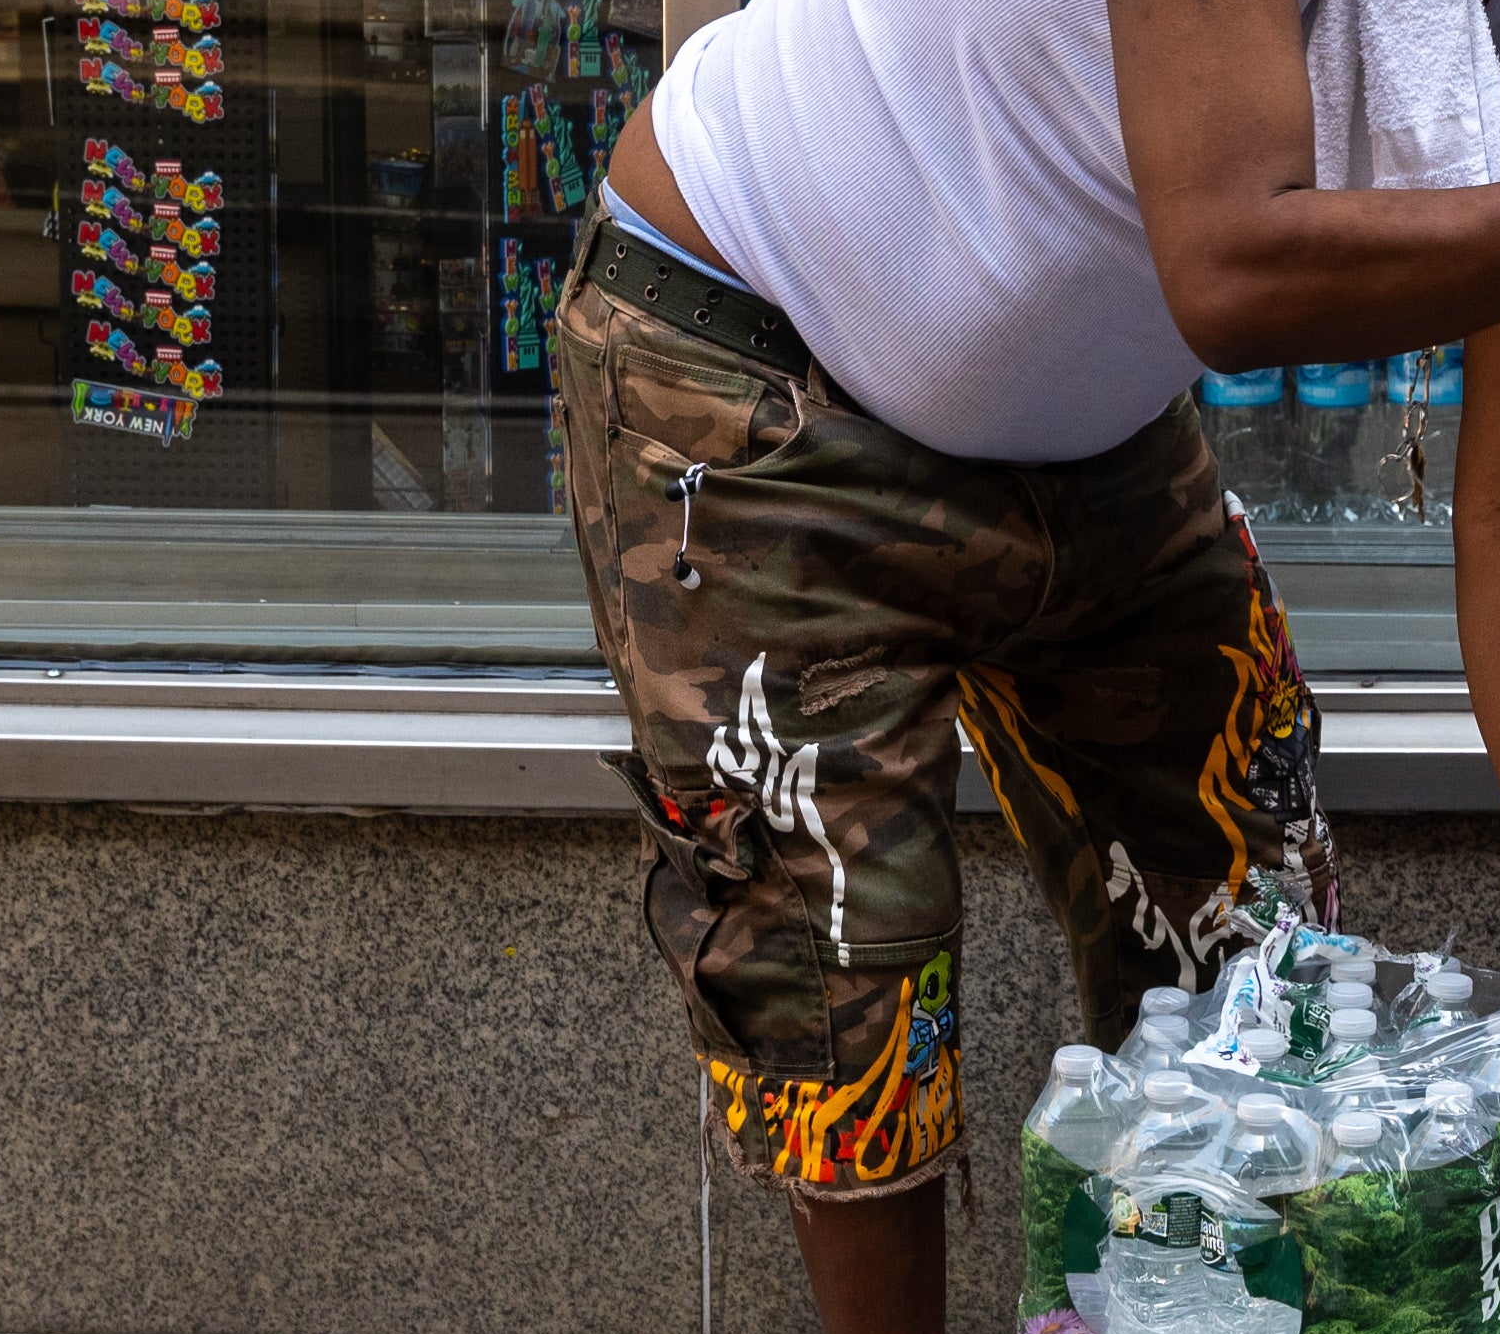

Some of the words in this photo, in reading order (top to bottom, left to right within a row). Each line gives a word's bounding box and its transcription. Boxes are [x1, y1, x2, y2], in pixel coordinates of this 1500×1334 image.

[77, 17, 136, 59] NEW
[151, 39, 224, 78] YORK
[80, 58, 138, 100] NEW
[151, 85, 224, 123] YORK
[84, 138, 138, 187] NEW
[151, 174, 223, 212] YORK
[81, 179, 136, 229] NEW
[149, 217, 221, 257] YORK
[78, 221, 132, 271] NEW
[144, 261, 215, 302] YORK
[71, 270, 130, 317] NEW
[139, 307, 212, 345] YORK
[87, 320, 141, 372] NEW
[151, 360, 223, 399] YORK
[82, 407, 127, 428] YORK
